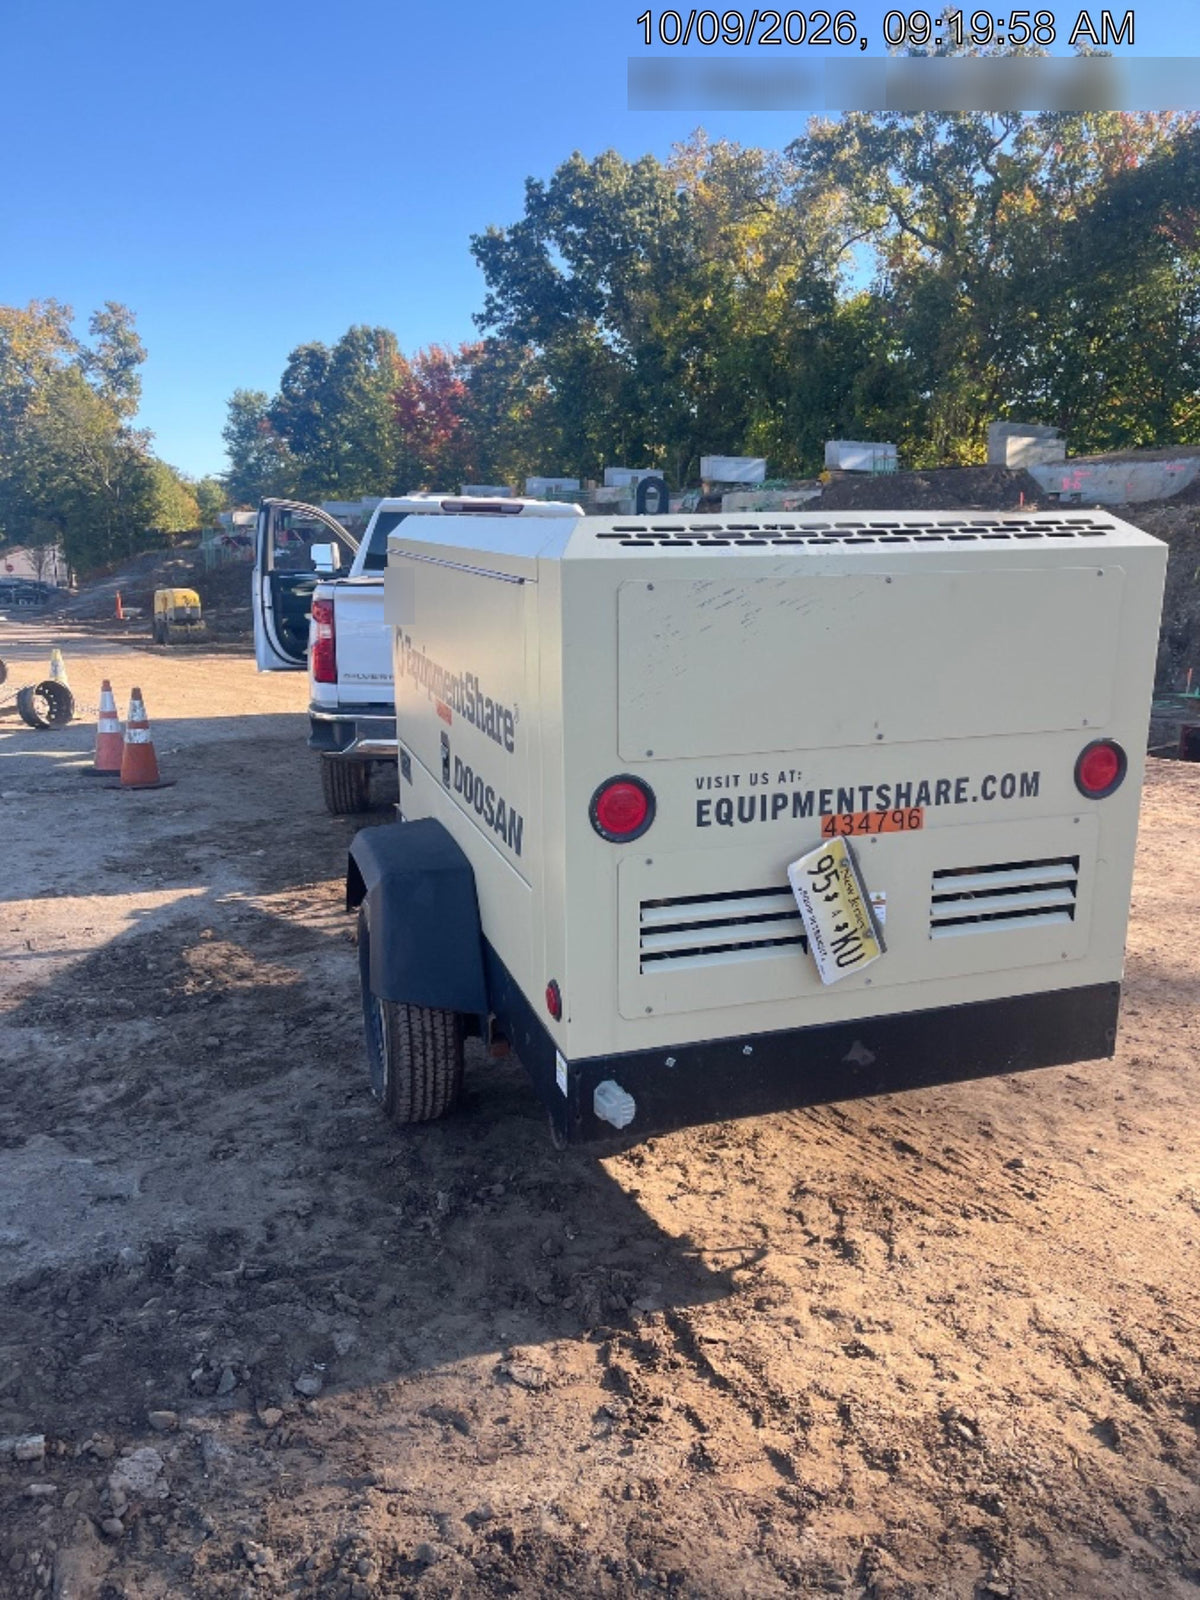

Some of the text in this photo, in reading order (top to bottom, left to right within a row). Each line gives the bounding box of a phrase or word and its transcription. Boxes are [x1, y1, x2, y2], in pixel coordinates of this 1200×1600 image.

[695, 769, 803, 790] VISIT US AT:
[696, 771, 1041, 827] EQUIPMENTSHARE.COM
[454, 754, 524, 857] DOOSAN
[823, 808, 922, 837] 434796
